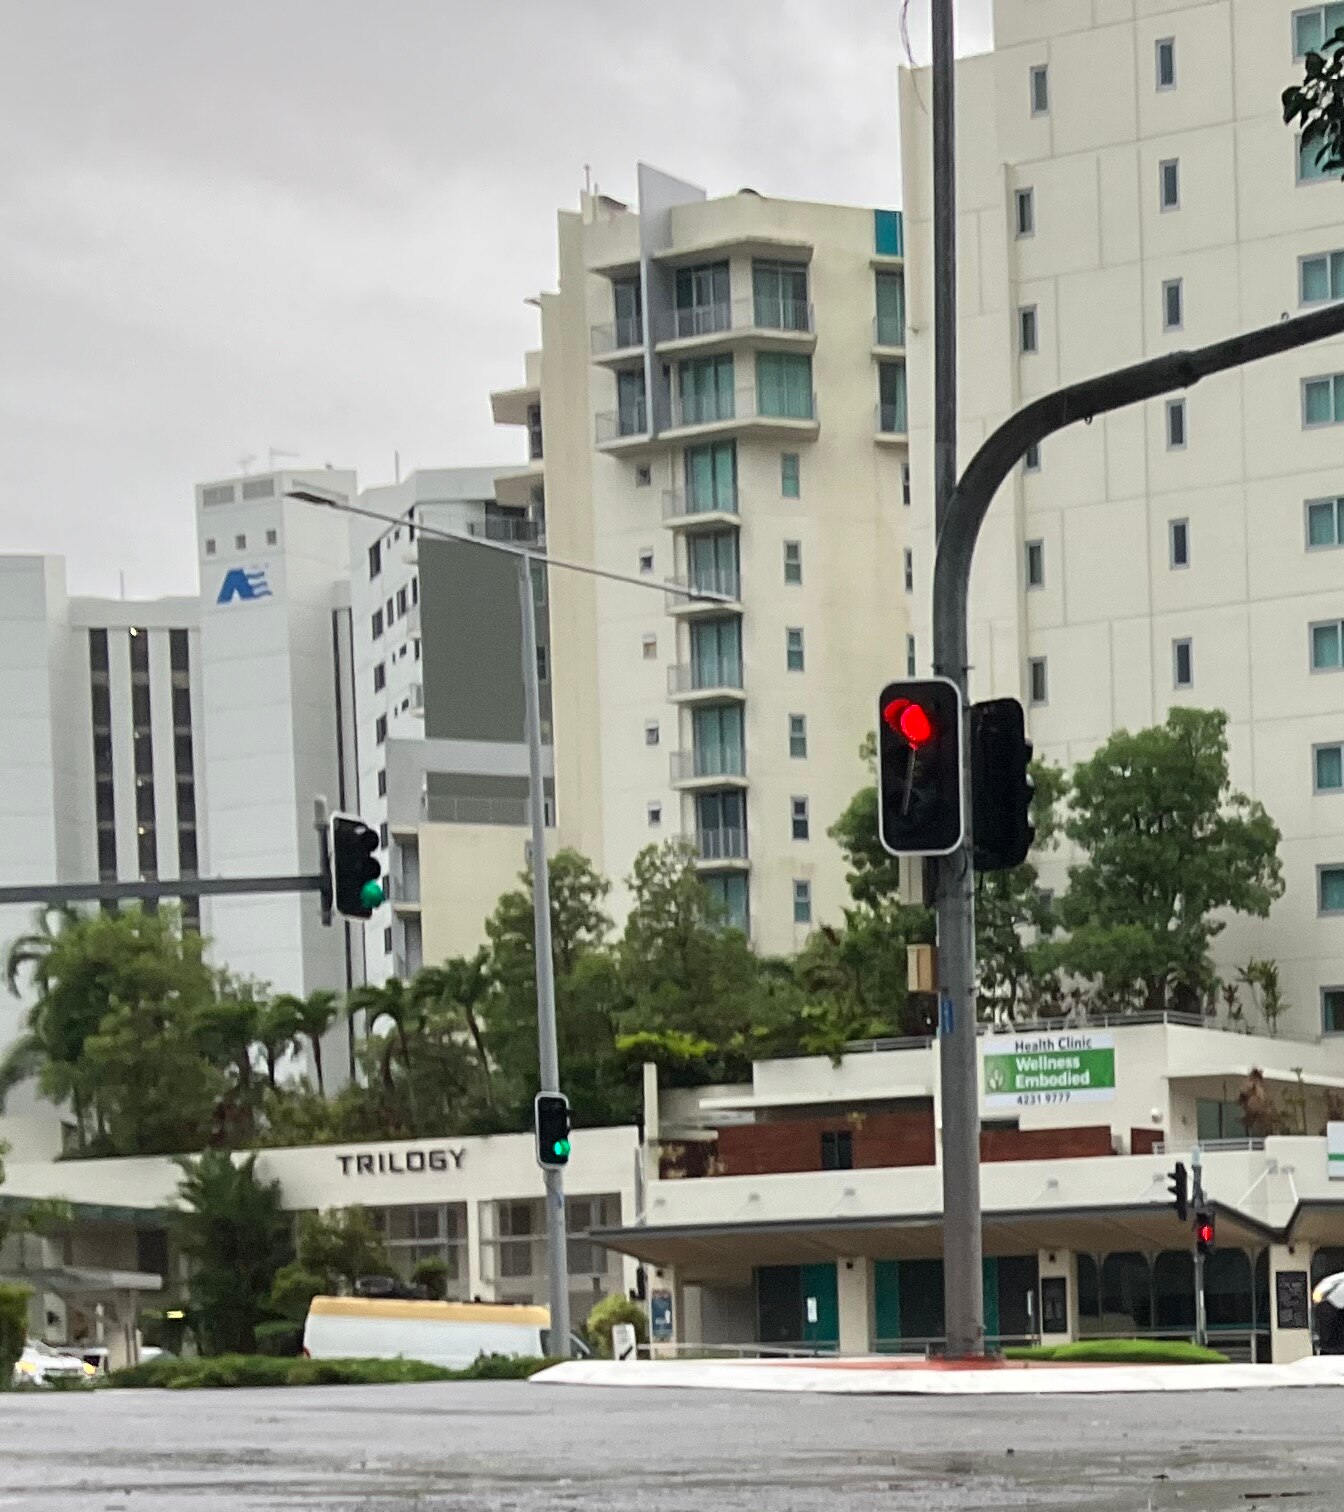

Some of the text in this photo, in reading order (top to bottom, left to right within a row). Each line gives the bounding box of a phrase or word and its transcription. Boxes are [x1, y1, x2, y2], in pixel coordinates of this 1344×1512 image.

[1015, 1035, 1092, 1053] Health Clinic
[1015, 1055, 1081, 1073] Wellness
[1015, 1069, 1091, 1090] Embodied
[336, 1148, 466, 1176] TRILOGY
